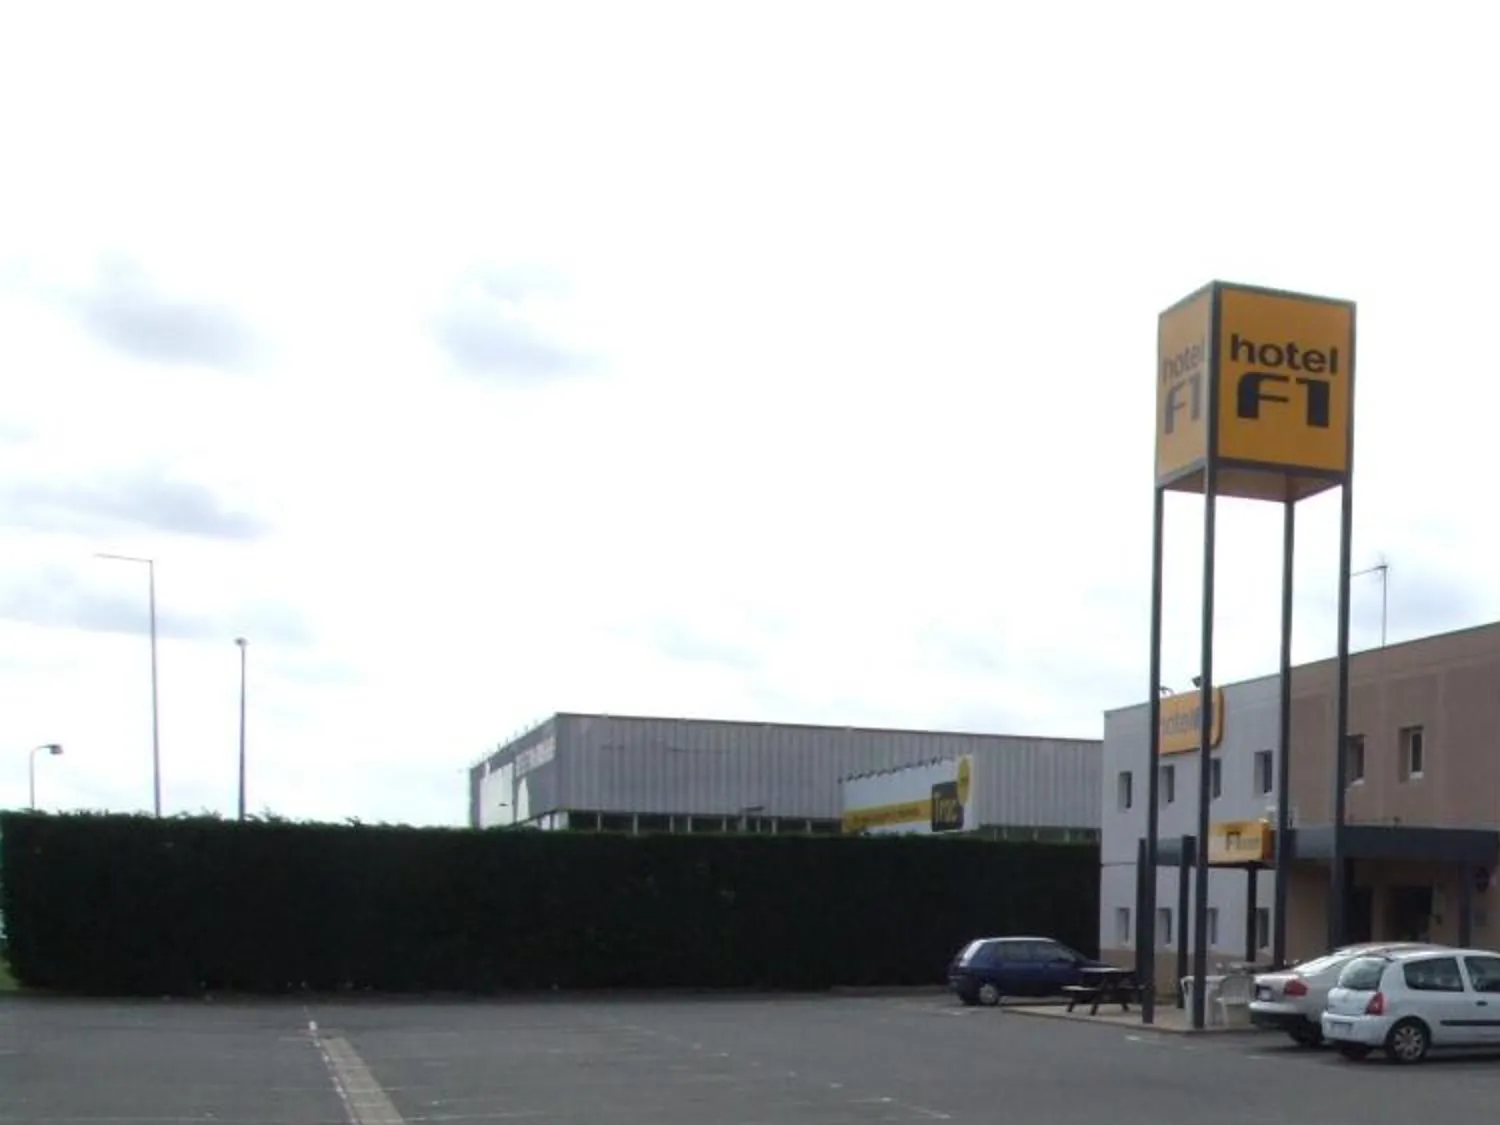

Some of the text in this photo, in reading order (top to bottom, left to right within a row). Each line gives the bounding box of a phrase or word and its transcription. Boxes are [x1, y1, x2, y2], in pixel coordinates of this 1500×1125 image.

[1162, 335, 1206, 380] hotel
[1230, 333, 1339, 376] hotel
[1164, 374, 1201, 435] F1
[1237, 371, 1331, 428] F1
